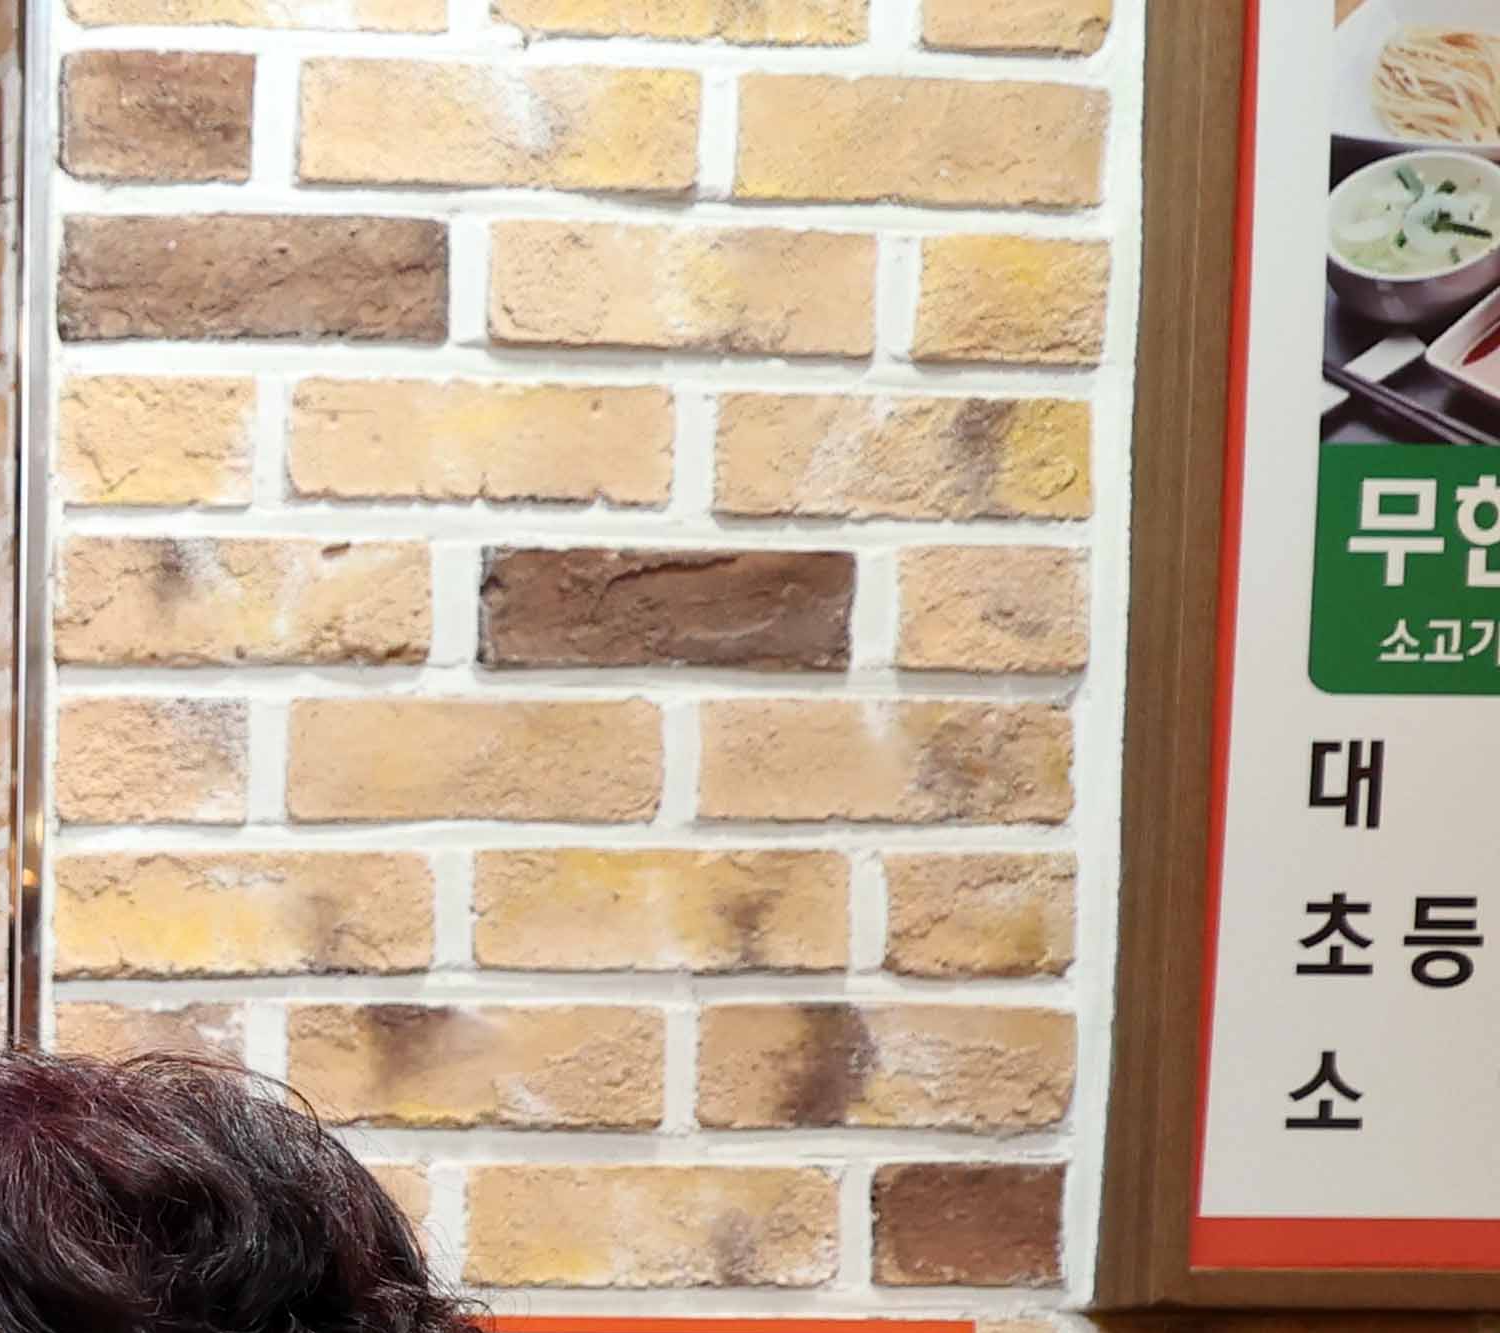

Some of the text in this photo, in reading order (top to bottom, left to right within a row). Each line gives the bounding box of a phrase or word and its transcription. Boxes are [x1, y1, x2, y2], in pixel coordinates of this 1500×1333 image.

[1378, 618, 1500, 668] 소고기
[1308, 739, 1385, 830] 대
[1284, 1050, 1364, 1130] 소
